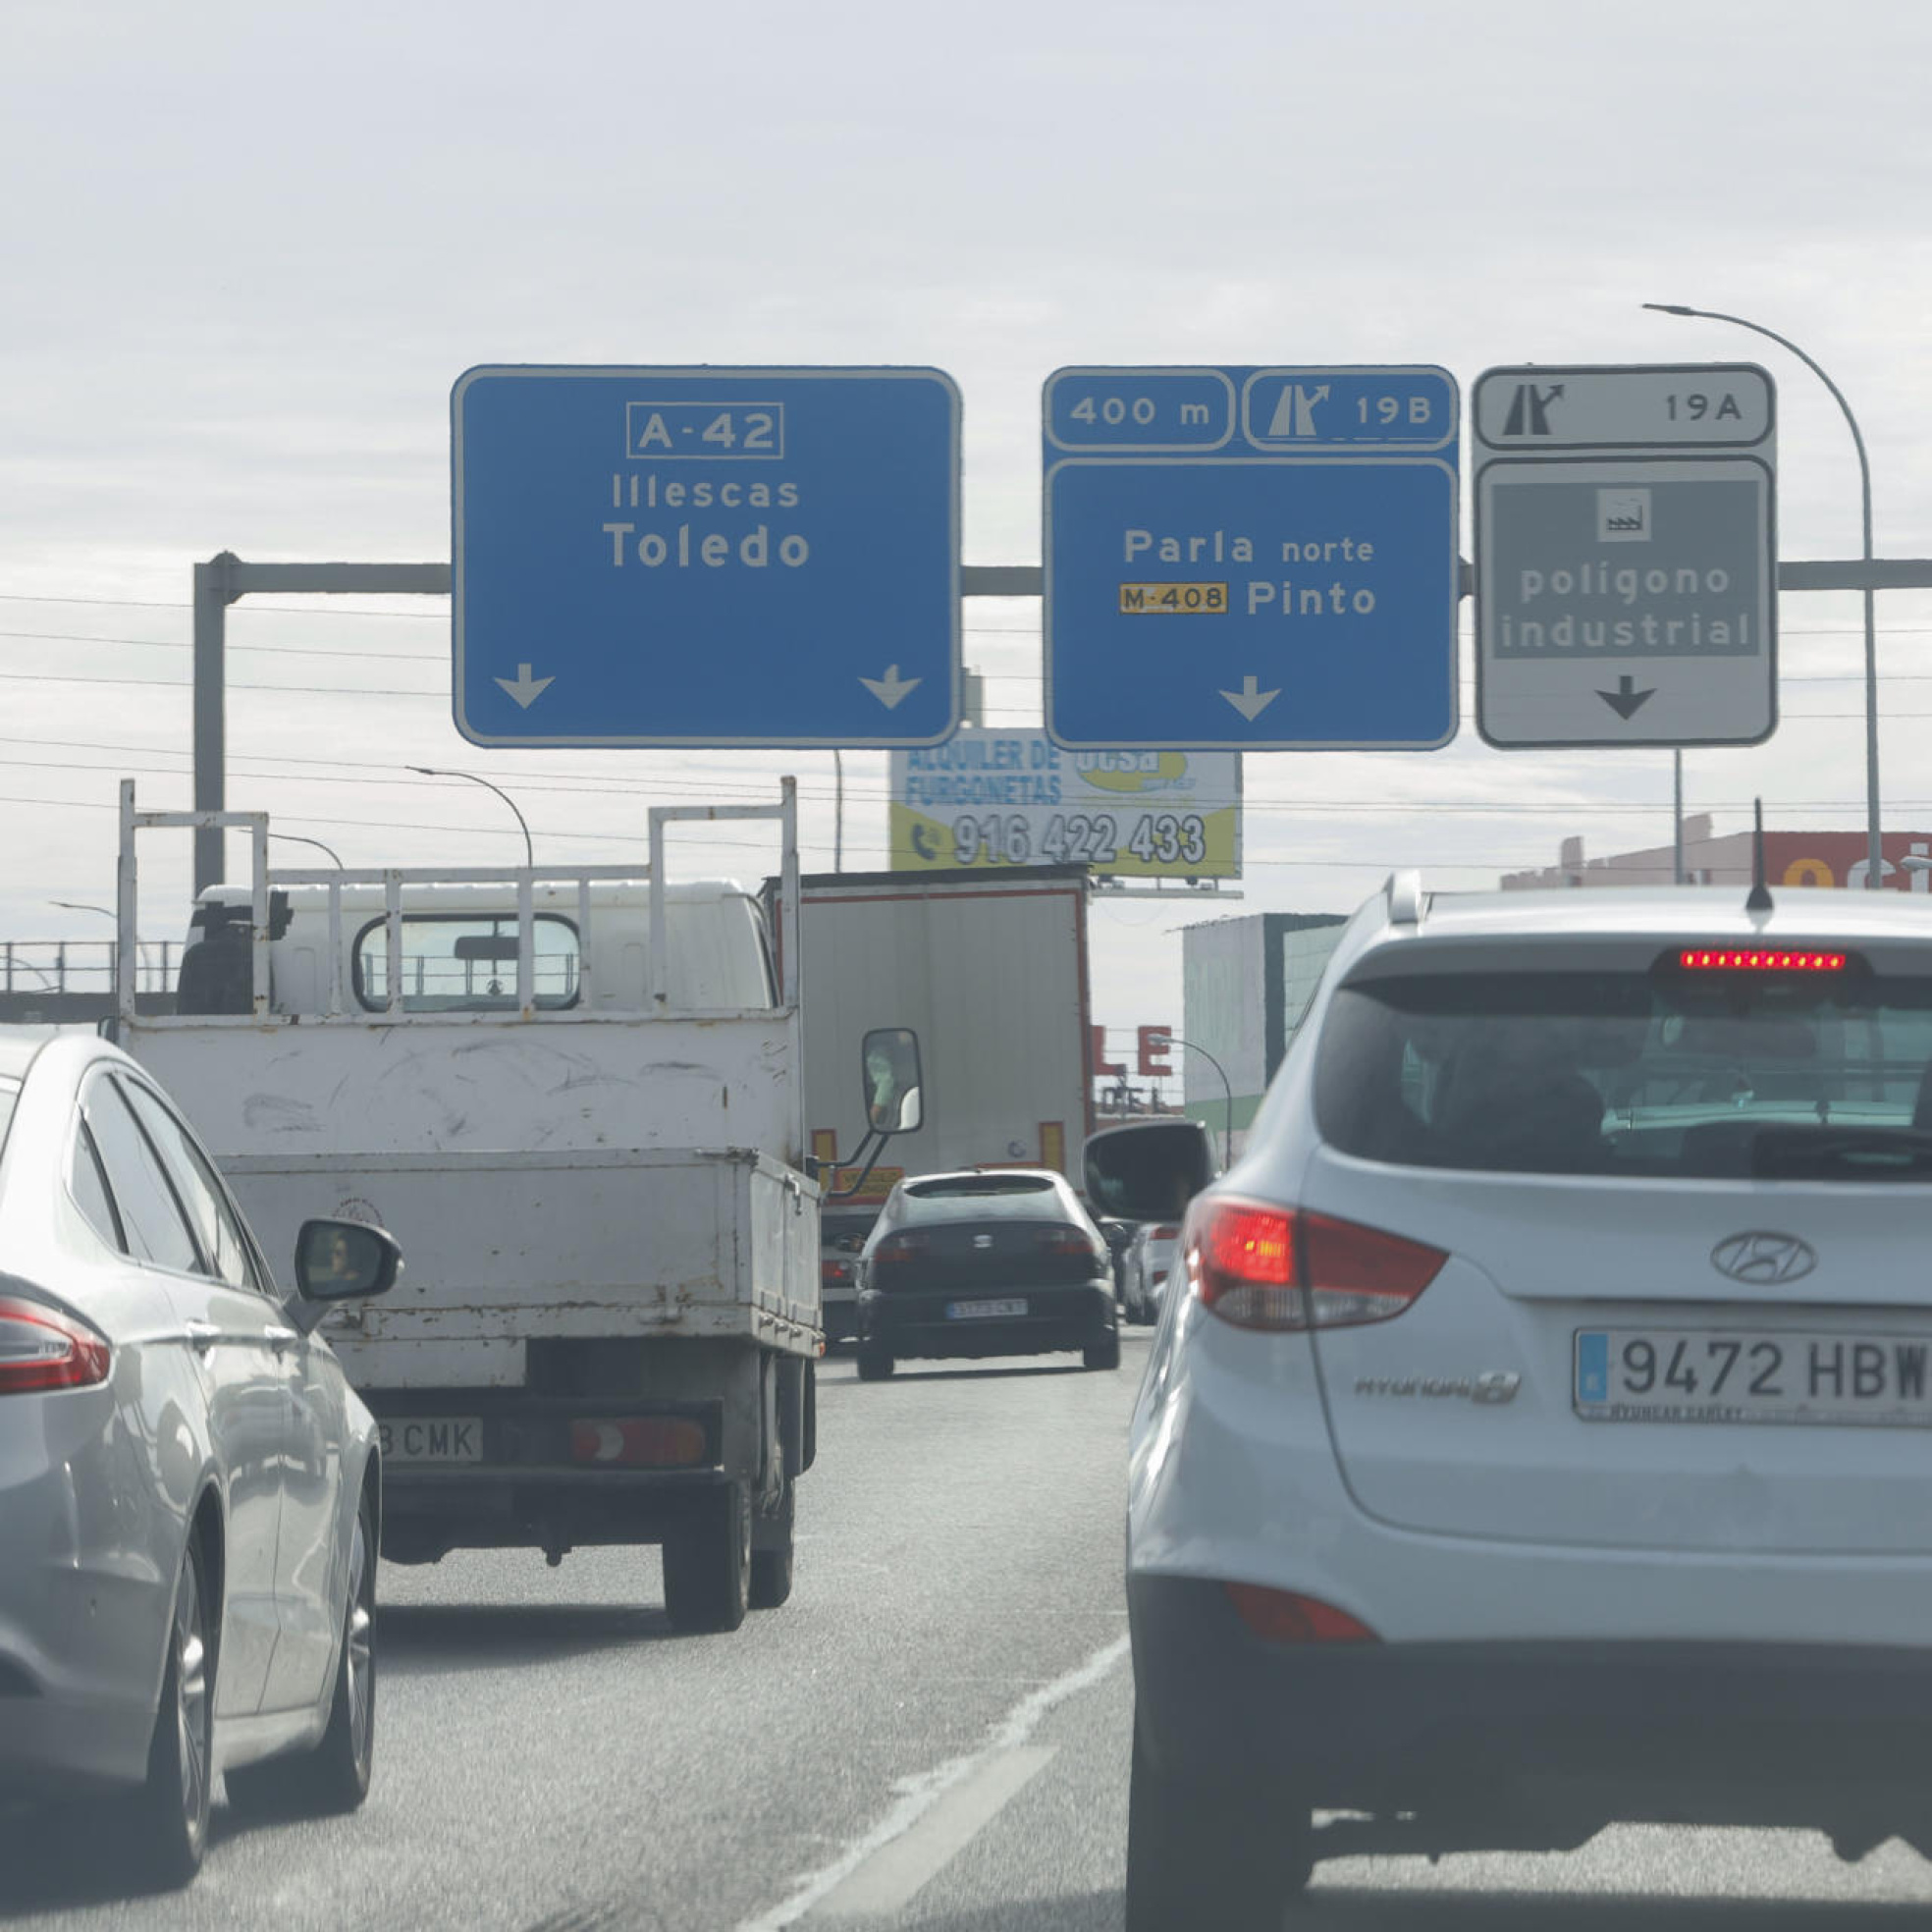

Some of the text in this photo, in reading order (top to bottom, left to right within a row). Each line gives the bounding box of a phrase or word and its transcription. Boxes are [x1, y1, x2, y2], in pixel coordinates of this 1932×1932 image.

[1069, 397, 1210, 426] 400 m
[1357, 396, 1432, 424] 19B
[1665, 393, 1742, 421] 19A
[638, 411, 775, 449] A-42
[613, 473, 799, 509] Illescas
[602, 521, 811, 568] Toledo
[1124, 528, 1375, 564] Parla norte
[1123, 580, 1376, 616] M-408 Pinto
[1520, 560, 1731, 605] polígono
[1501, 612, 1750, 648] industrial
[1029, 739, 1060, 771] DE
[952, 815, 1206, 865] 916 422 433
[1622, 1338, 1928, 1401] 9472 HBW
